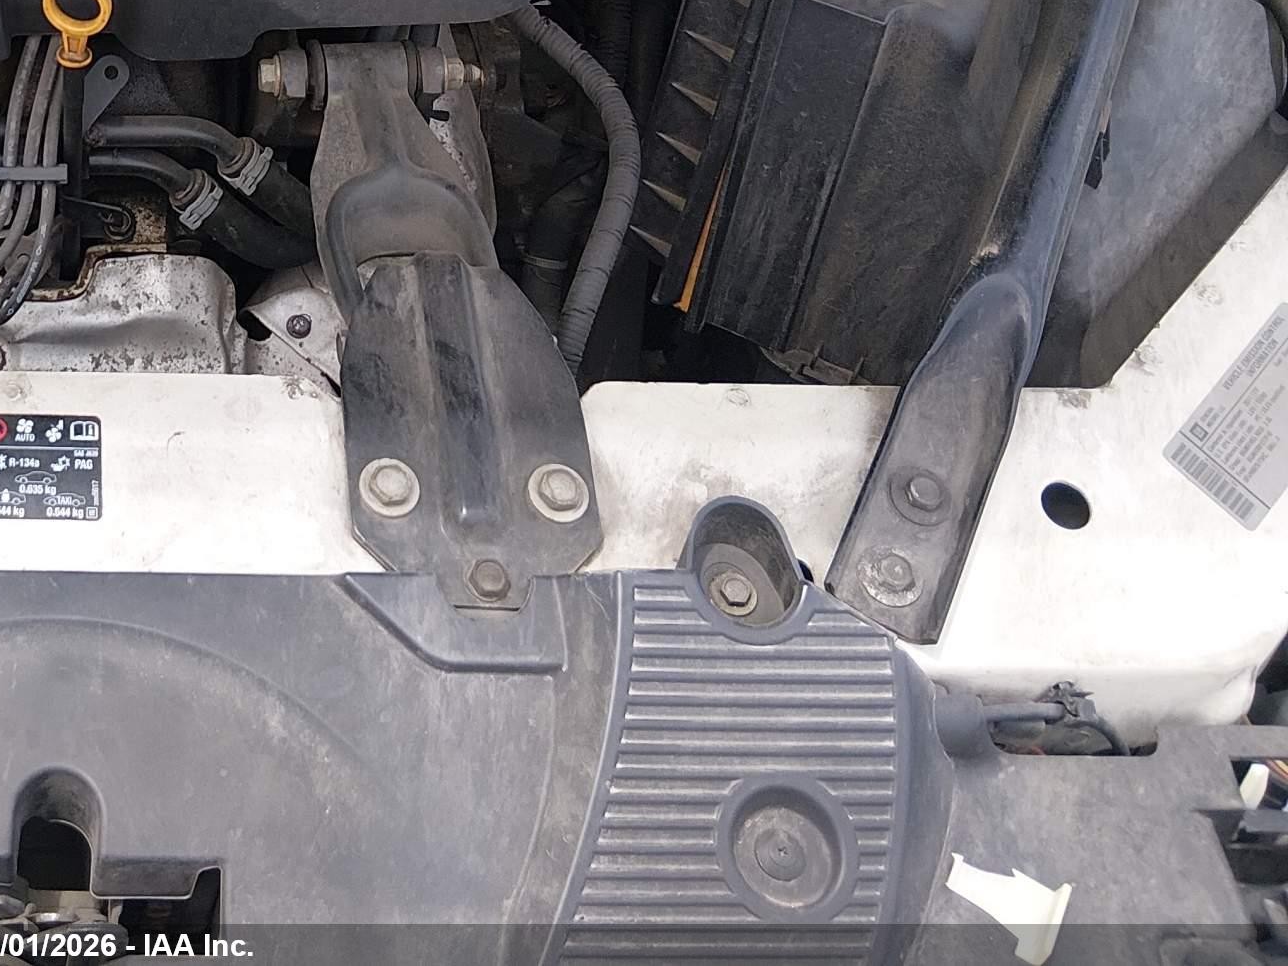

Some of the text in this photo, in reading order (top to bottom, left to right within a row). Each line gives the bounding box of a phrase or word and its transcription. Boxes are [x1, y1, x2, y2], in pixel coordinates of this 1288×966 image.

[15, 433, 35, 442] AUTO
[8, 457, 40, 468] R-134a
[74, 458, 93, 470] PAG
[19, 484, 57, 496] 0.635 kg
[57, 495, 72, 506] TAXI
[13, 505, 25, 518] kg
[46, 507, 71, 518] 0.544
[72, 507, 84, 519] kg
